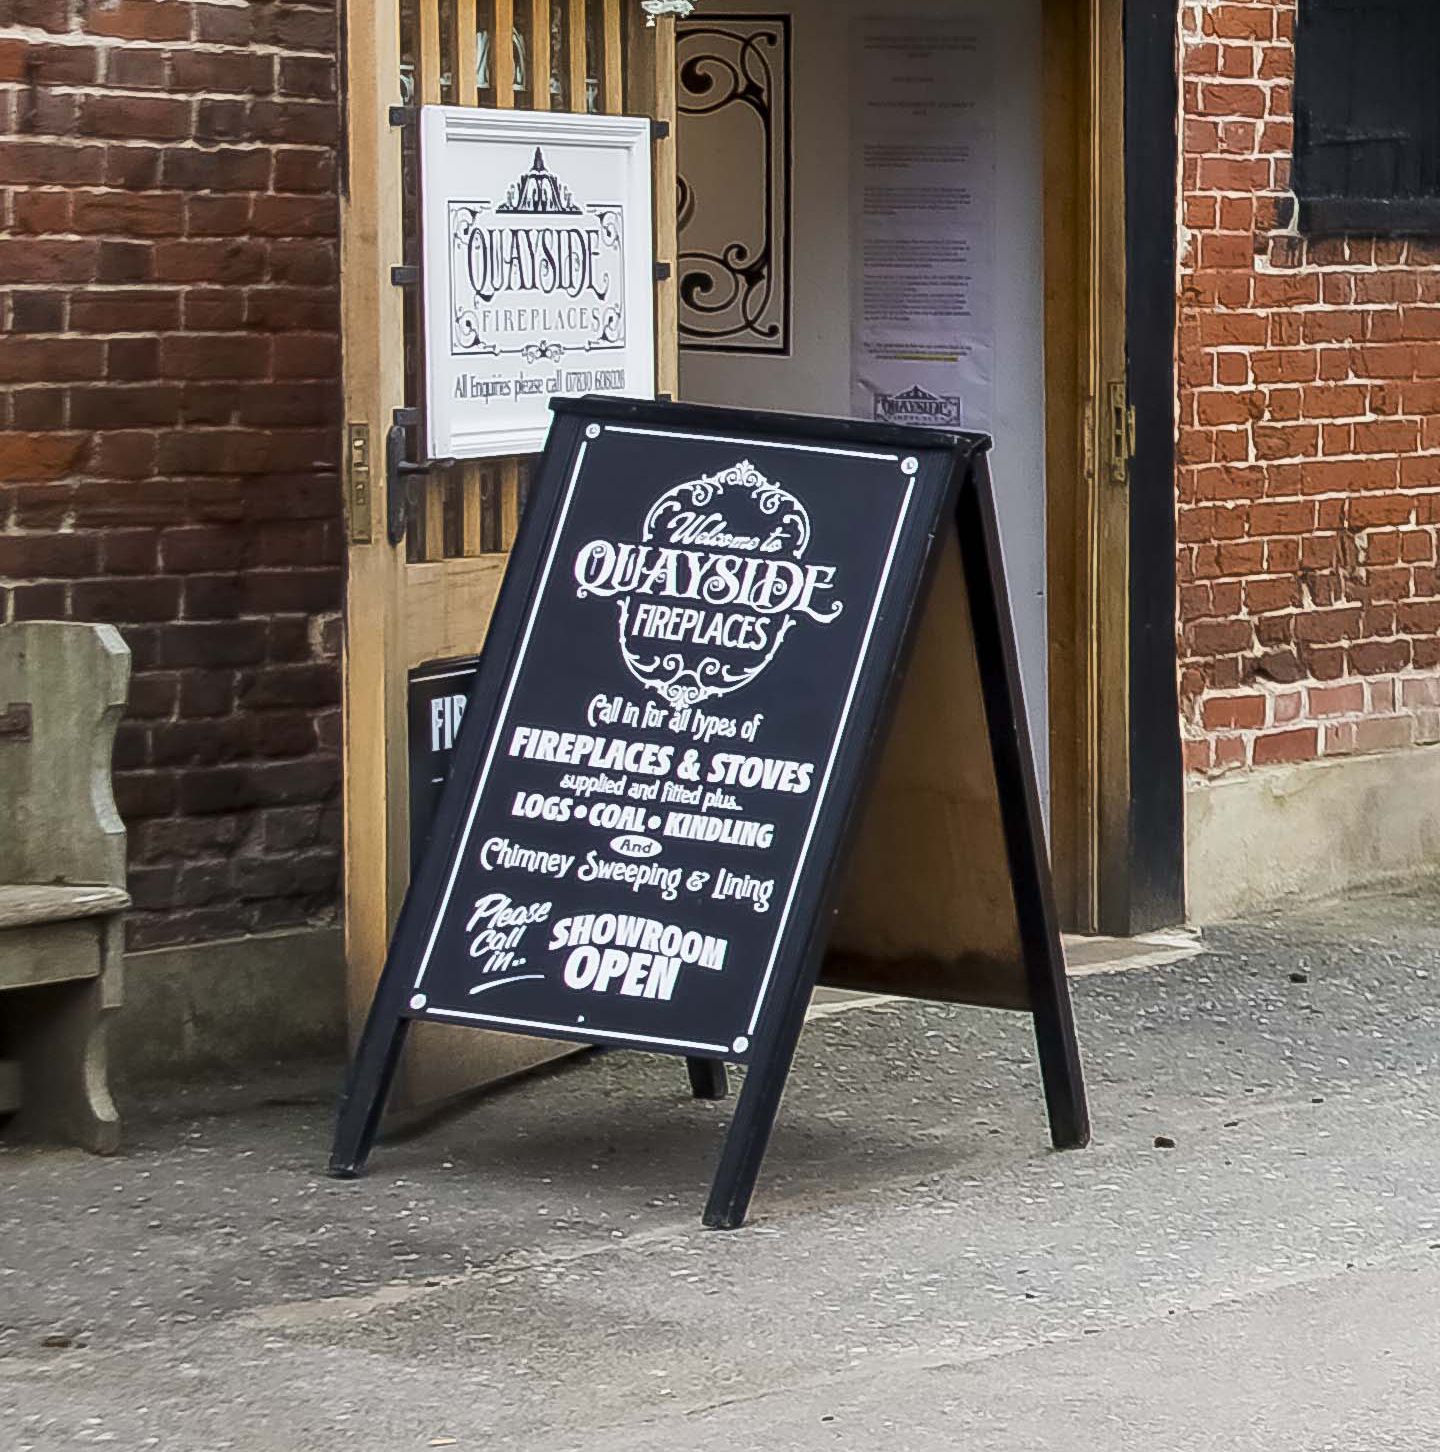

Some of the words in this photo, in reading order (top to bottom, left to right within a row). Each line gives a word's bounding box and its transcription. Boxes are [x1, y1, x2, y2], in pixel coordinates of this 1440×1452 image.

[467, 227, 609, 309] QUAYSIDE
[481, 308, 602, 333] FIREPLACES
[454, 374, 468, 398] All
[470, 374, 511, 405] Enquiries
[514, 371, 543, 403] please
[546, 369, 562, 394] call
[667, 512, 760, 550] Welcome
[760, 526, 790, 552] to
[574, 539, 844, 623] QUAYSIDE
[631, 604, 770, 650] FIREPLACES
[587, 694, 624, 727] Call
[622, 702, 639, 728] in
[640, 701, 669, 729] for
[669, 707, 692, 733] all
[692, 709, 737, 742] types
[740, 713, 764, 742] of
[509, 726, 675, 776] FIREPLACES
[677, 749, 700, 781] &
[707, 753, 814, 794] STOVES
[560, 772, 624, 797] supplied
[628, 779, 659, 800] and
[661, 781, 700, 806] fitted
[511, 791, 574, 822] LOGS
[589, 802, 646, 833] COAL
[663, 811, 774, 848] KINDLING
[619, 839, 652, 854] And
[480, 837, 575, 878] Chimney
[577, 850, 682, 901] Sweeping
[686, 871, 710, 891] &
[711, 868, 774, 913] Lining
[466, 893, 552, 932] Please
[470, 925, 527, 957] Call
[549, 913, 728, 970] SHOWROOM
[563, 945, 682, 1000] OPEN
